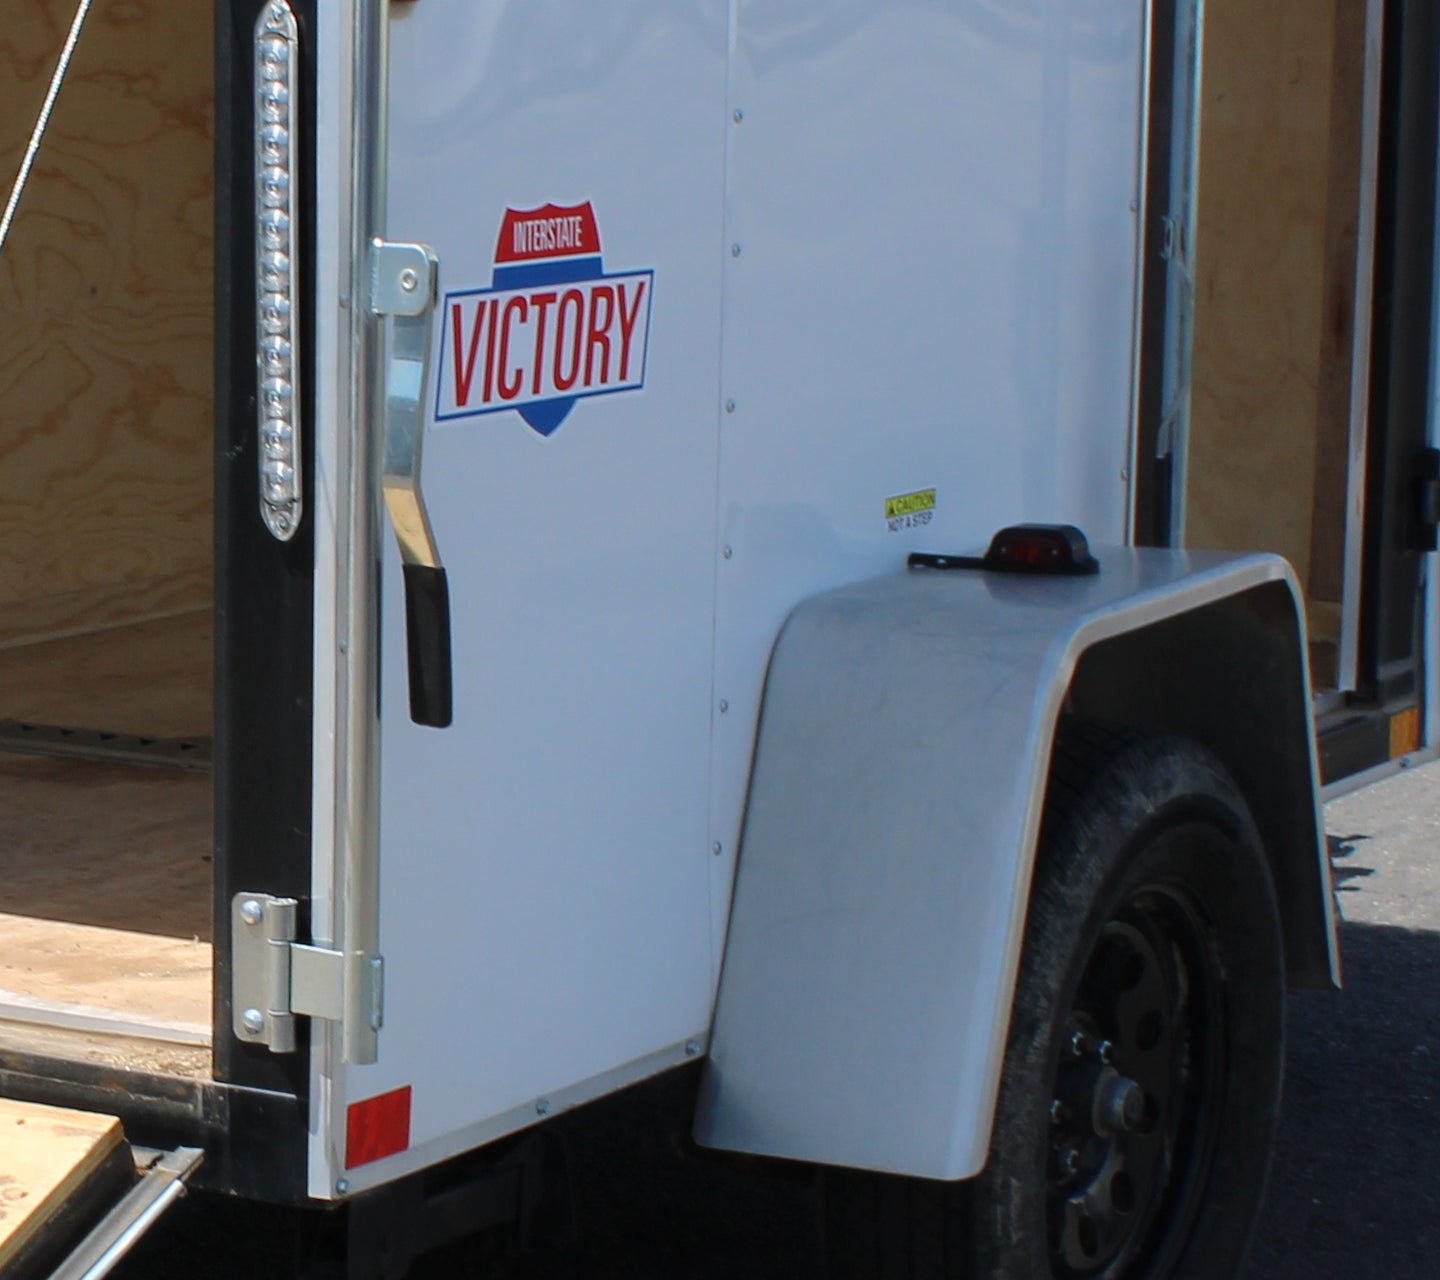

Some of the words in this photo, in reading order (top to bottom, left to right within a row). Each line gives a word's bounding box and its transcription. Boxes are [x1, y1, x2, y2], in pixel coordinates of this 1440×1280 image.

[513, 216, 583, 253] INTERSTATE
[452, 282, 646, 407] VICTORY
[895, 493, 935, 512] CAUTION
[888, 517, 904, 532] NOT
[913, 511, 932, 527] STEP
